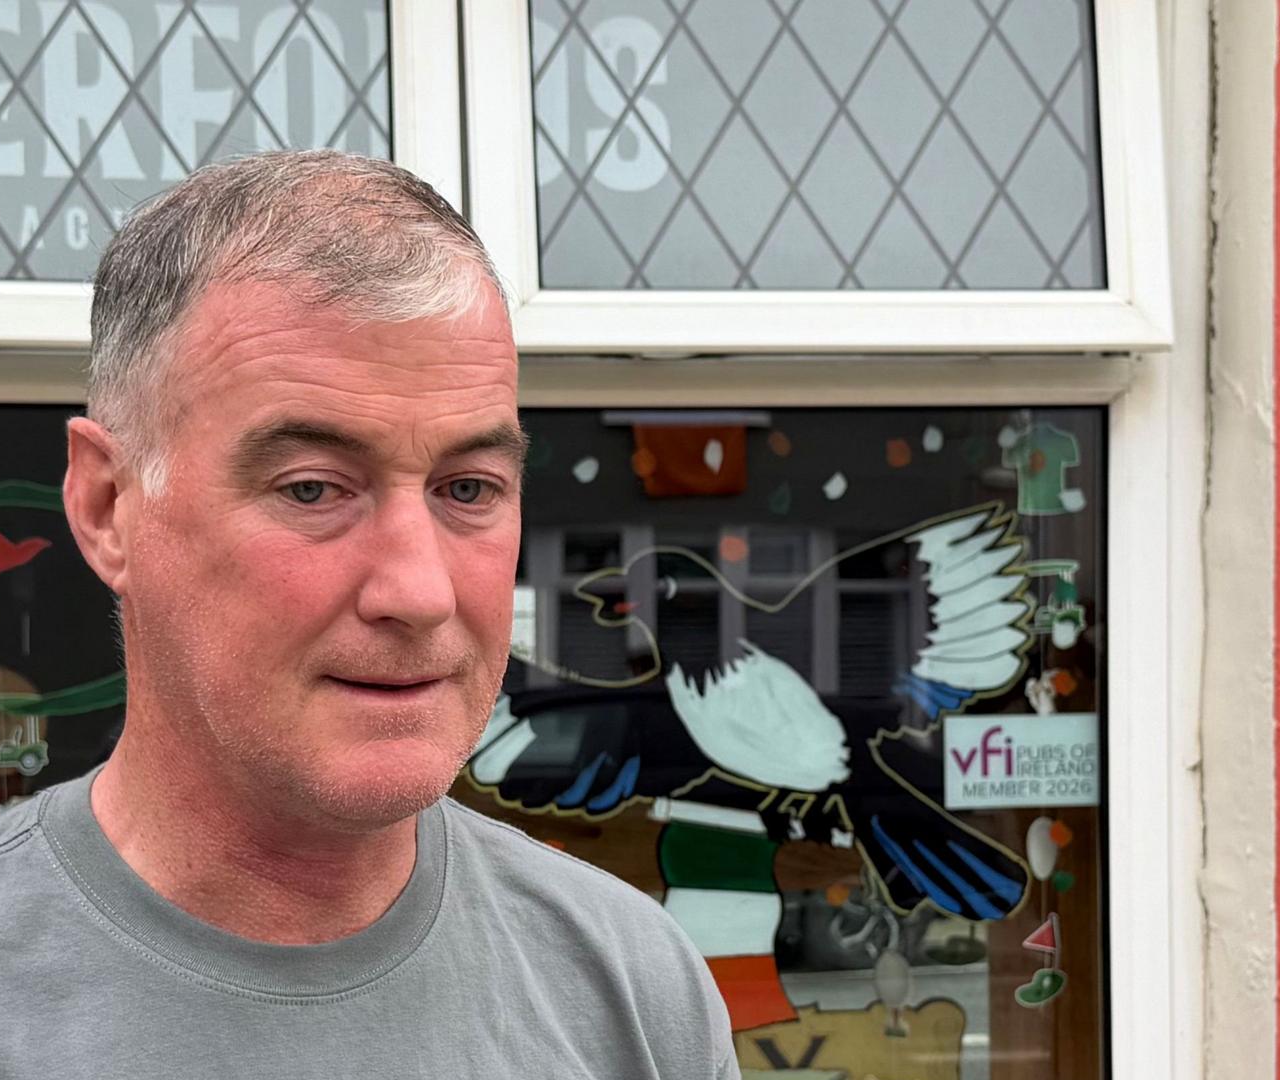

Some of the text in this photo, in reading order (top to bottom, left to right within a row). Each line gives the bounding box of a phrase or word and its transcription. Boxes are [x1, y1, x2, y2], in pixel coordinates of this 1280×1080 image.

[19, 204, 125, 251] AG
[951, 725, 1014, 777] vfi
[1016, 743, 1096, 760] PUBS OF
[1016, 760, 1096, 777] IRELAND
[962, 778, 1094, 798] MEMBER 2026
